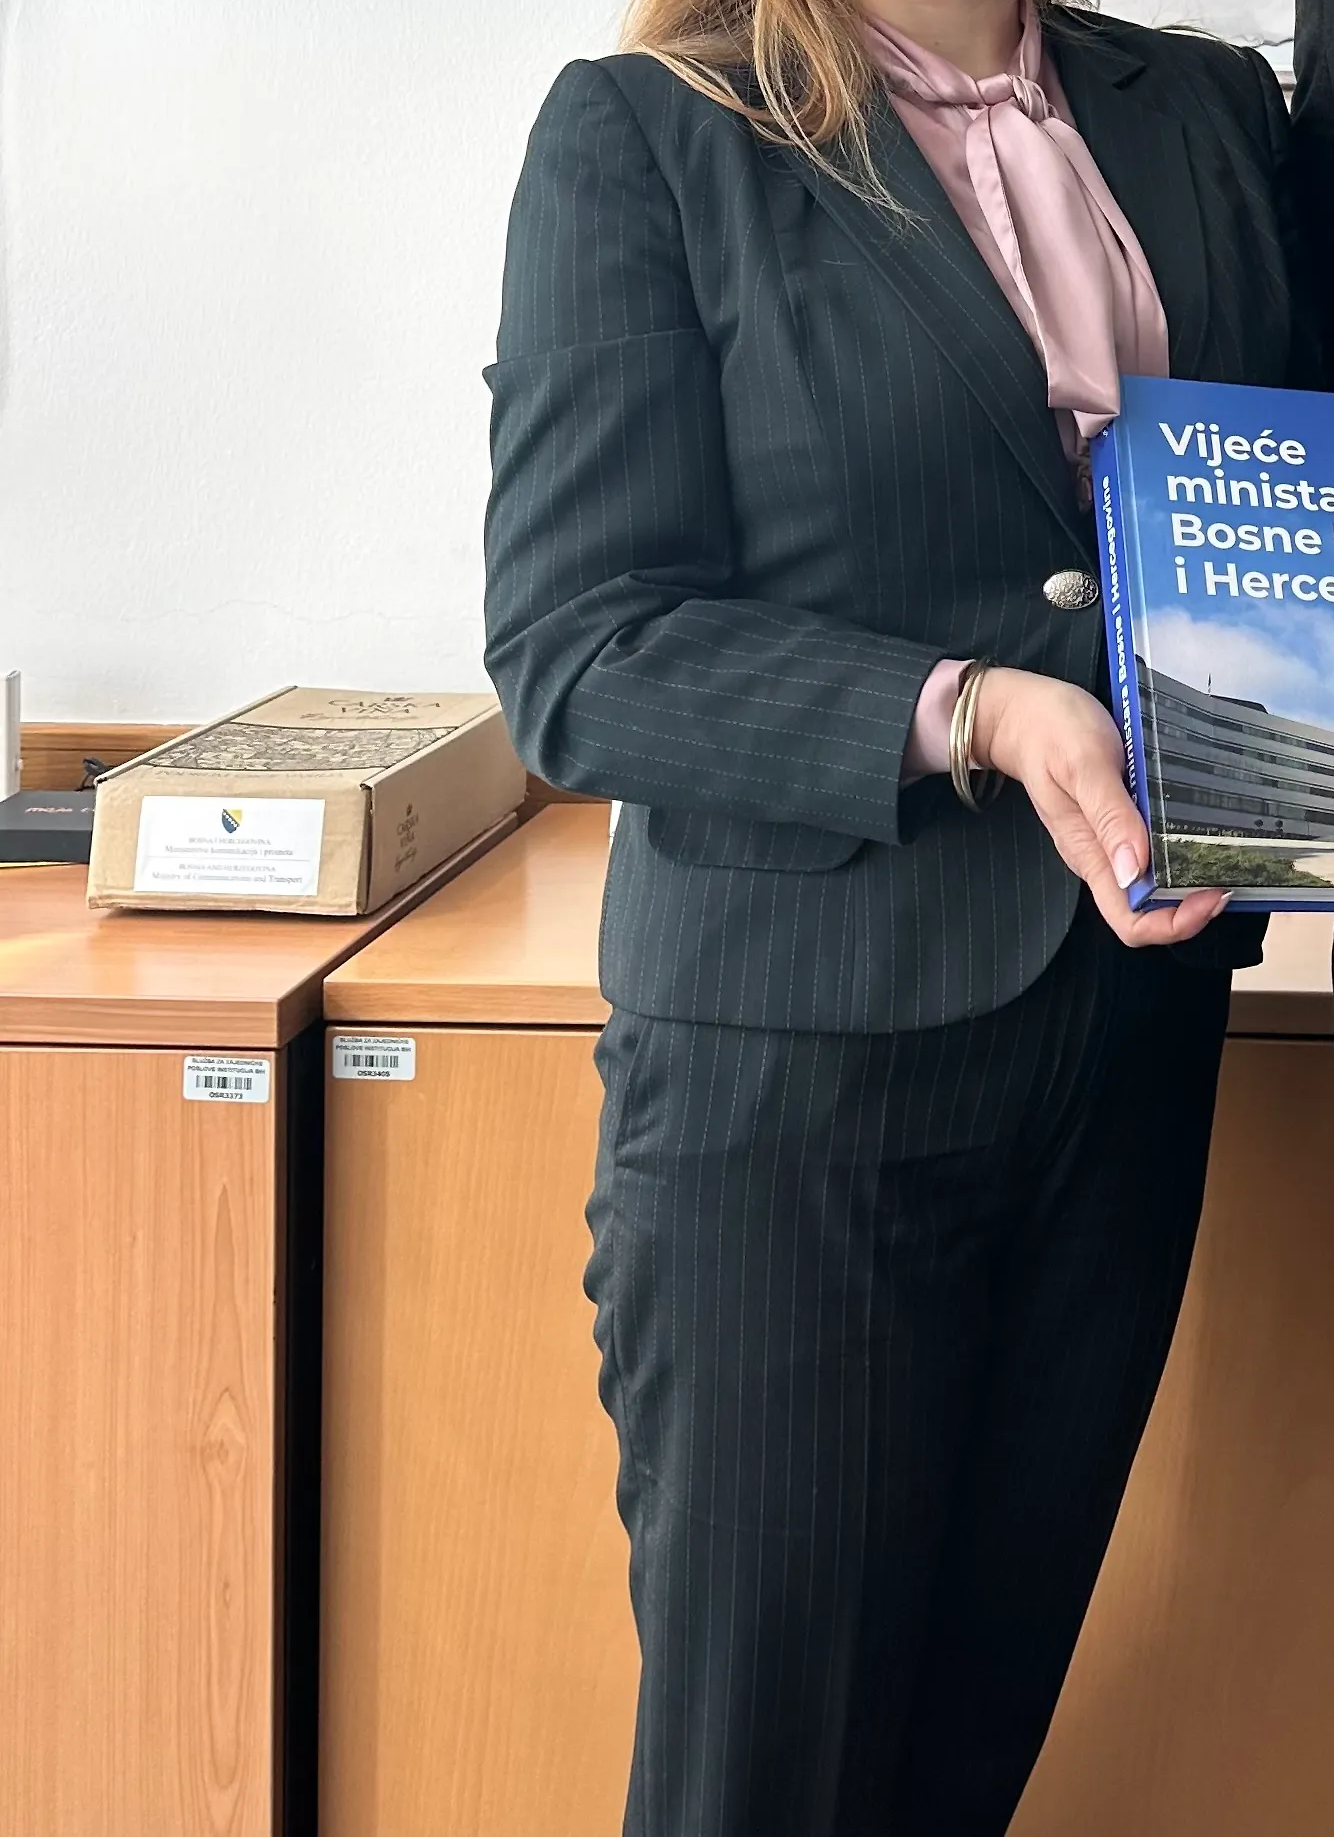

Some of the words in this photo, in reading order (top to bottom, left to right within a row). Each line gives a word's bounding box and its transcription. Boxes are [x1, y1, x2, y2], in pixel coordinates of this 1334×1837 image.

[1159, 422, 1306, 466] Vijeće
[1102, 475, 1120, 603] Hercegovine
[1171, 513, 1322, 555] Bosne
[1174, 556, 1189, 594] i
[1114, 616, 1127, 683] Bosne
